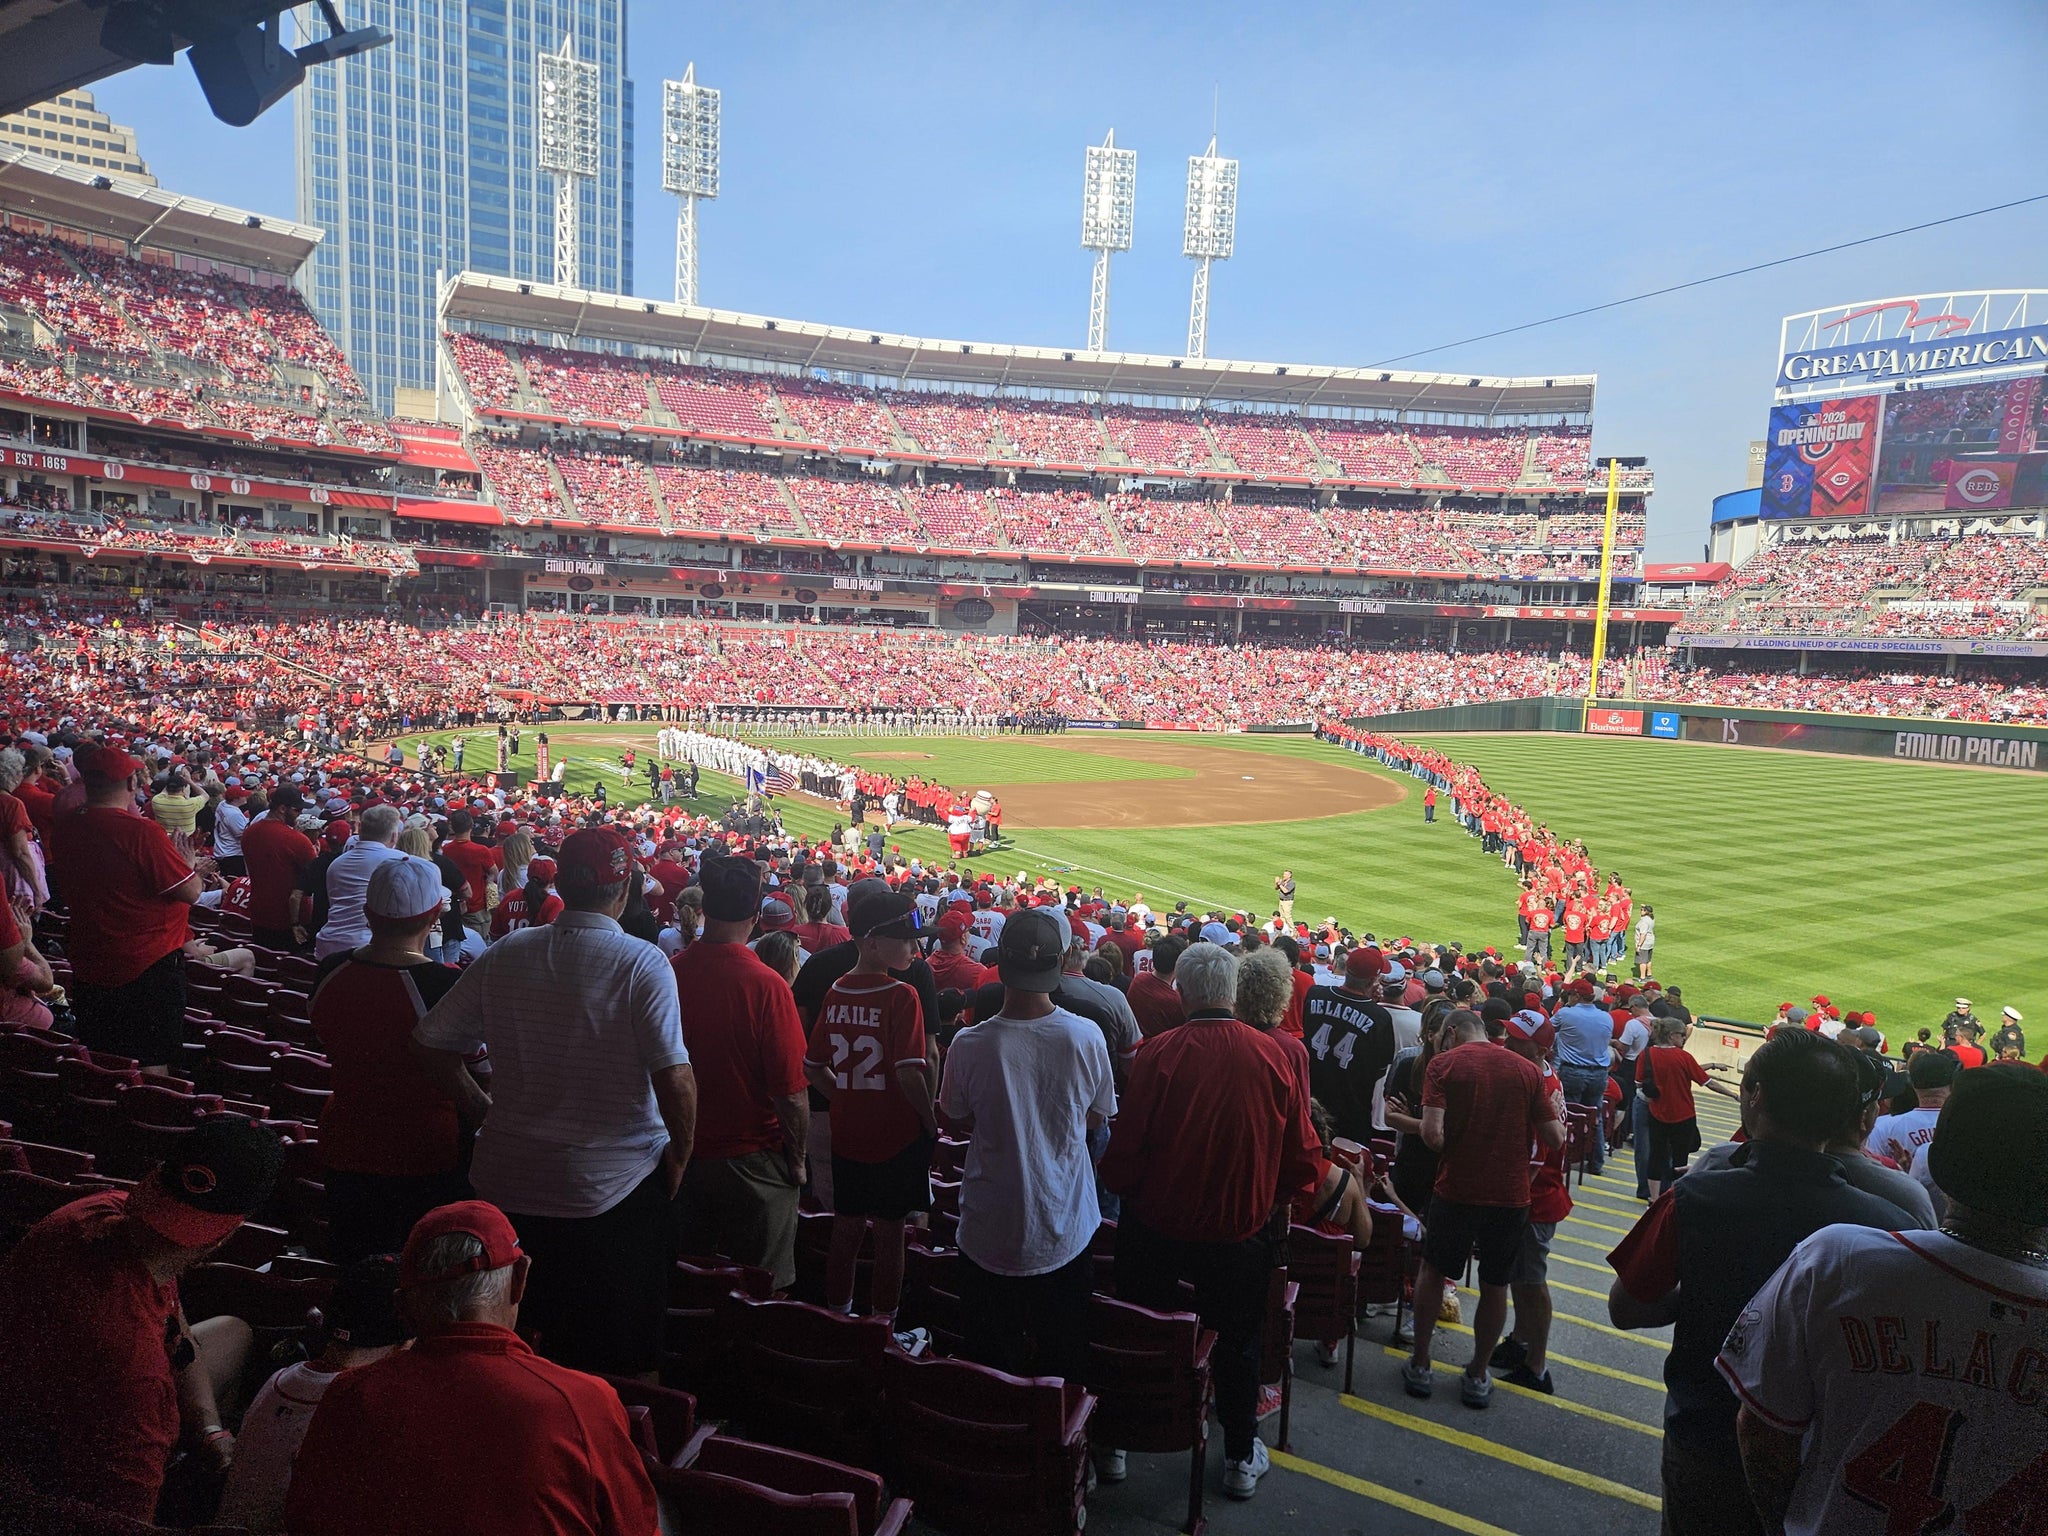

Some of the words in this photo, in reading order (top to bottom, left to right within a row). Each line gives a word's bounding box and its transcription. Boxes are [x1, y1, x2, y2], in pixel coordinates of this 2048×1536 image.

[1785, 348, 1887, 382] GREAT
[1874, 334, 2048, 378] AMERICAN
[1822, 411, 1846, 424] 2026
[1777, 424, 1836, 446] OPENING
[1836, 422, 1866, 440] DAY
[264, 443, 280, 451] CLUB
[15, 451, 38, 467] EST.
[42, 455, 67, 471] 1869
[236, 479, 246, 493] 11
[1967, 481, 2000, 492] REDS
[545, 560, 575, 573] EMILIO
[575, 561, 605, 575] PAGAN
[718, 569, 727, 583] 15
[833, 577, 857, 590] EMILIO
[858, 578, 883, 592] PAGAN
[983, 586, 991, 598] 15
[1090, 591, 1113, 603] EMILIO
[1114, 592, 1138, 604] PAGAN
[1237, 597, 1244, 608] 15
[1338, 601, 1361, 613] EMILIO
[1362, 602, 1386, 614] PAGAN
[1698, 637, 1725, 645] Elizabeth
[1745, 639, 1751, 647] A
[1753, 639, 1791, 648] LEADING
[1792, 640, 1824, 648] LINEUP
[1825, 641, 1838, 649] OF
[1840, 642, 1879, 650] CANCER
[1882, 643, 1942, 651] SPECIALISTS
[1996, 645, 2033, 653] Elizabeth
[1590, 722, 1640, 733] Budweiser
[1722, 718, 1739, 743] 15
[1894, 732, 1961, 761] EMILIO
[1964, 736, 2038, 768] PAGAN
[231, 887, 251, 909] 32
[508, 900, 528, 912] VOT
[975, 917, 992, 925] SABO
[826, 1004, 882, 1028] MAILE
[1310, 999, 1324, 1015] DE
[1325, 1001, 1342, 1019] LA
[1342, 1006, 1375, 1034] CRUZ
[1311, 1023, 1358, 1070] 44
[829, 1033, 886, 1091] 22
[1908, 1127, 1936, 1147] GRI
[1839, 1316, 1911, 1375] DE
[1921, 1320, 2000, 1392] LA
